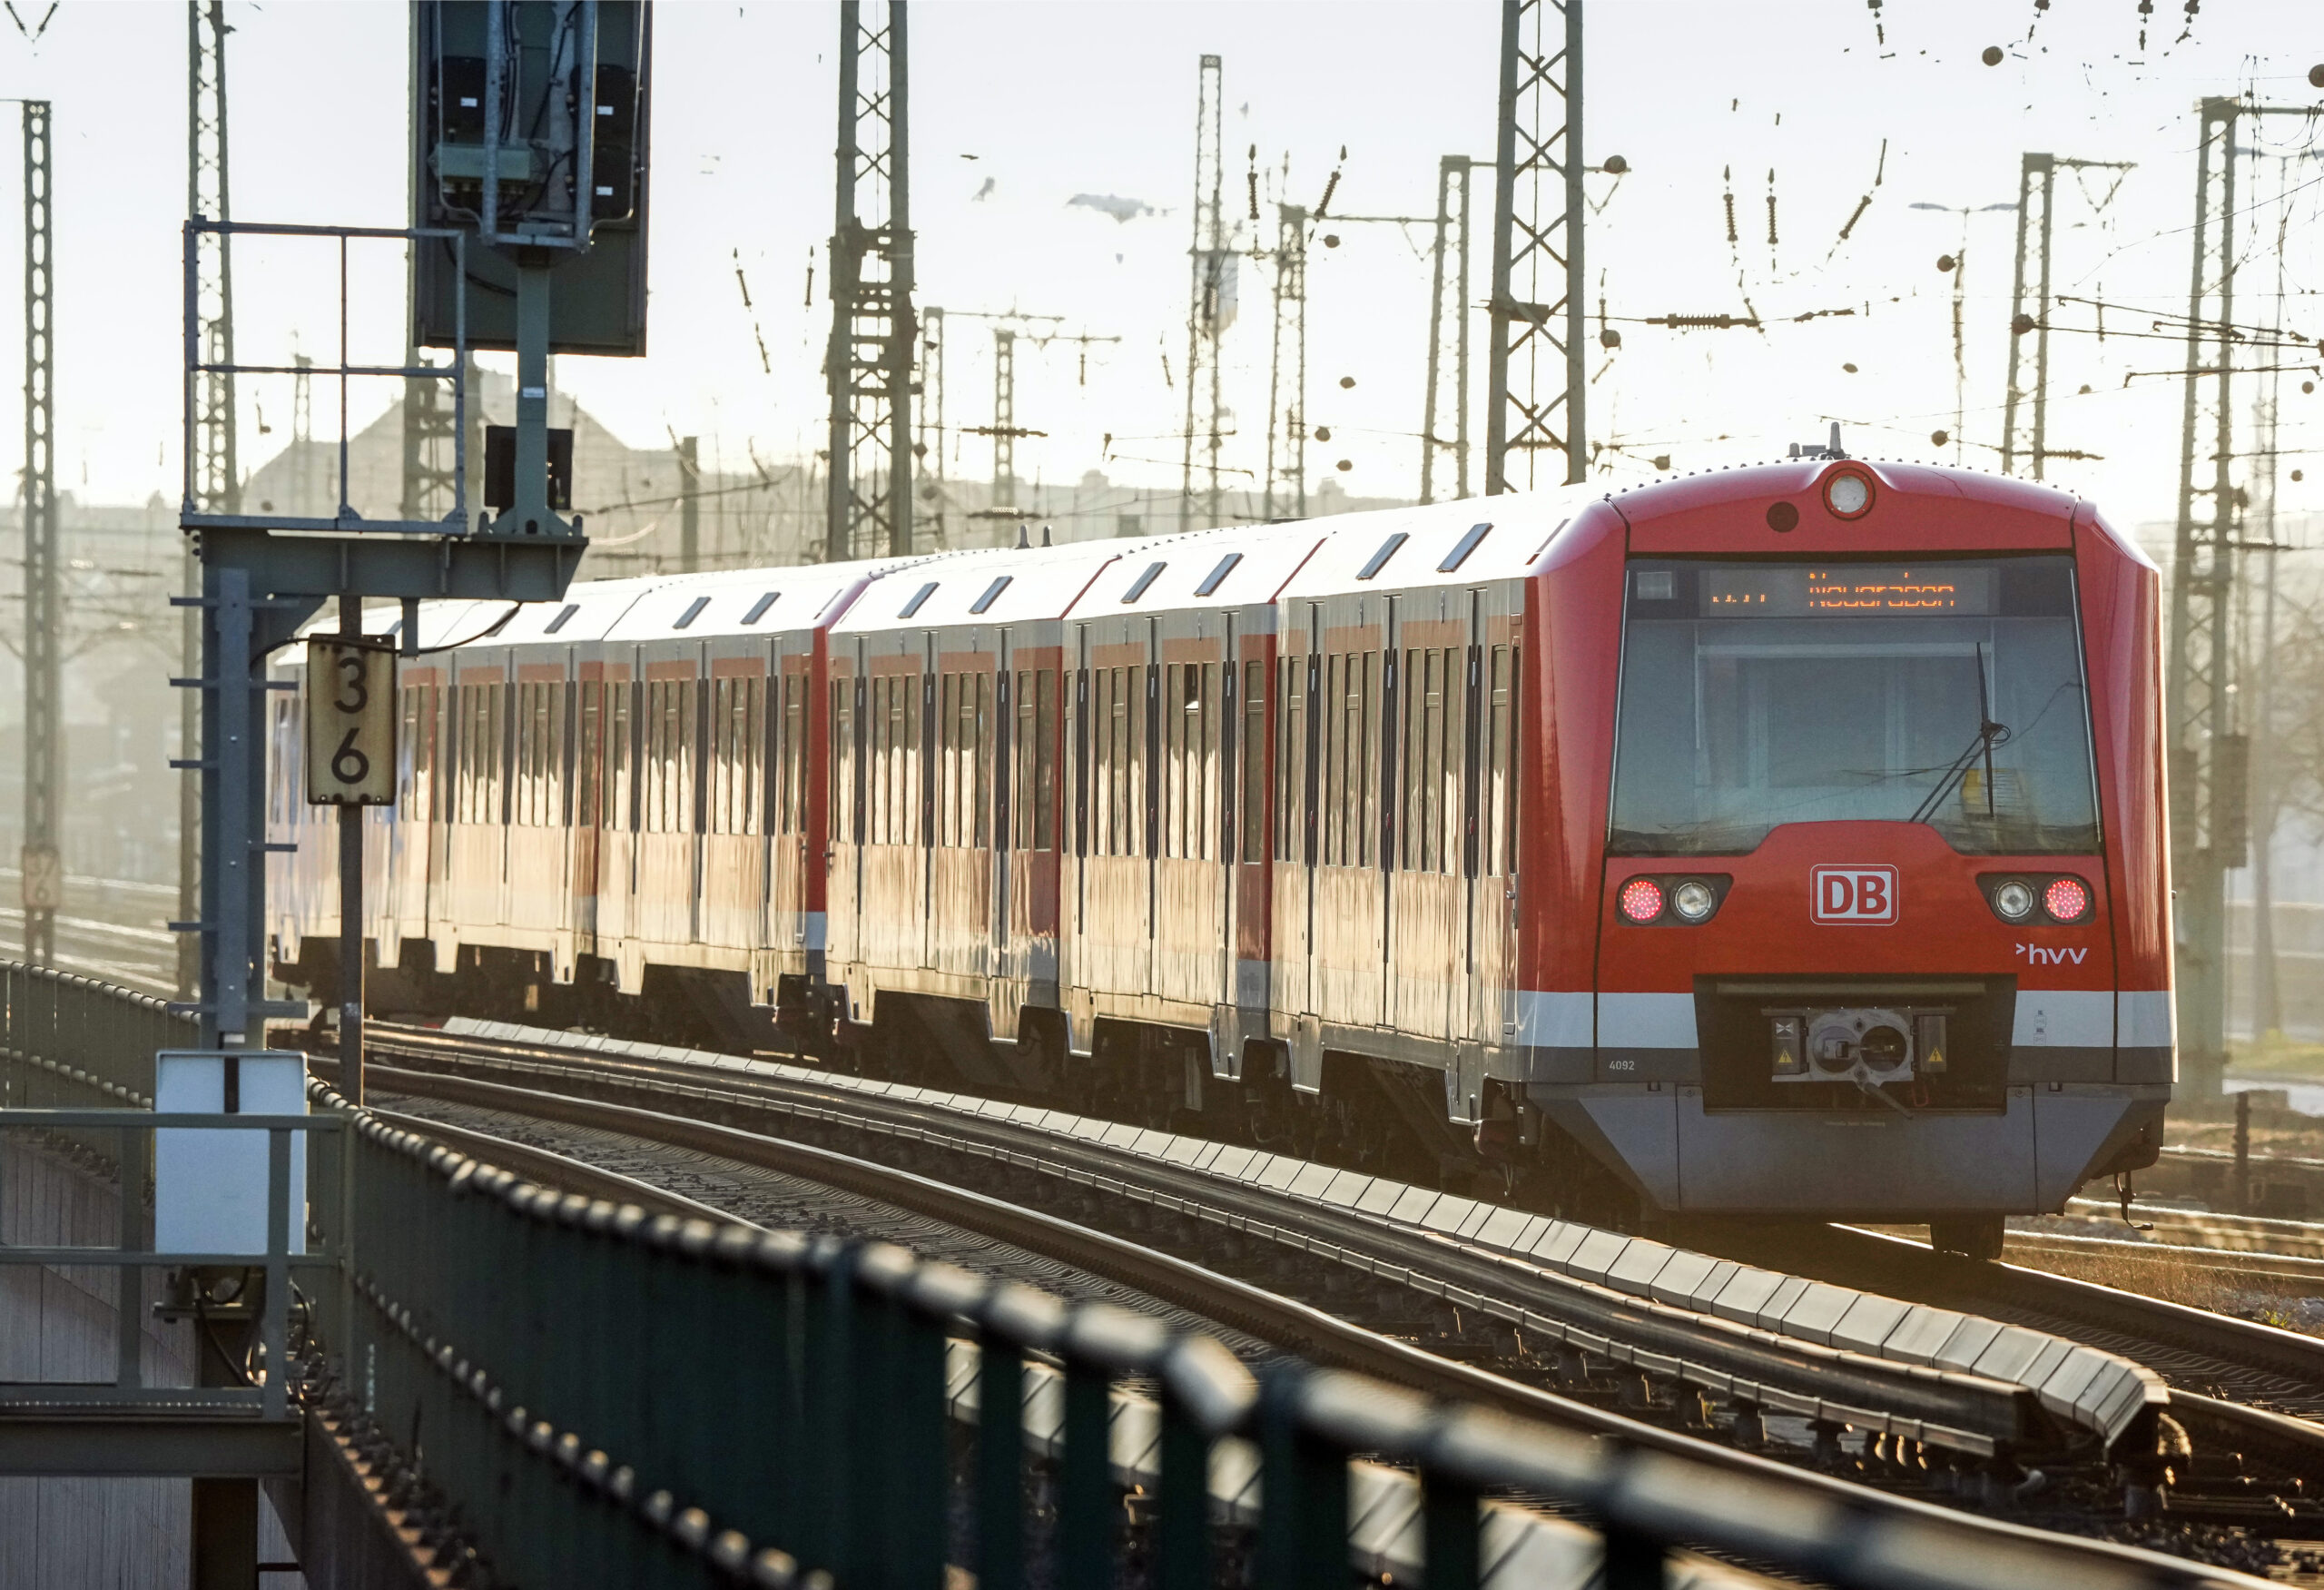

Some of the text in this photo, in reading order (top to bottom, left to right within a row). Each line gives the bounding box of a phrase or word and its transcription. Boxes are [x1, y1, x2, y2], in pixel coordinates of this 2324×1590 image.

[333, 657, 369, 714] 3
[331, 727, 369, 785] 6
[1823, 874, 1887, 914] DB
[1609, 1060, 1635, 1071] 4092
